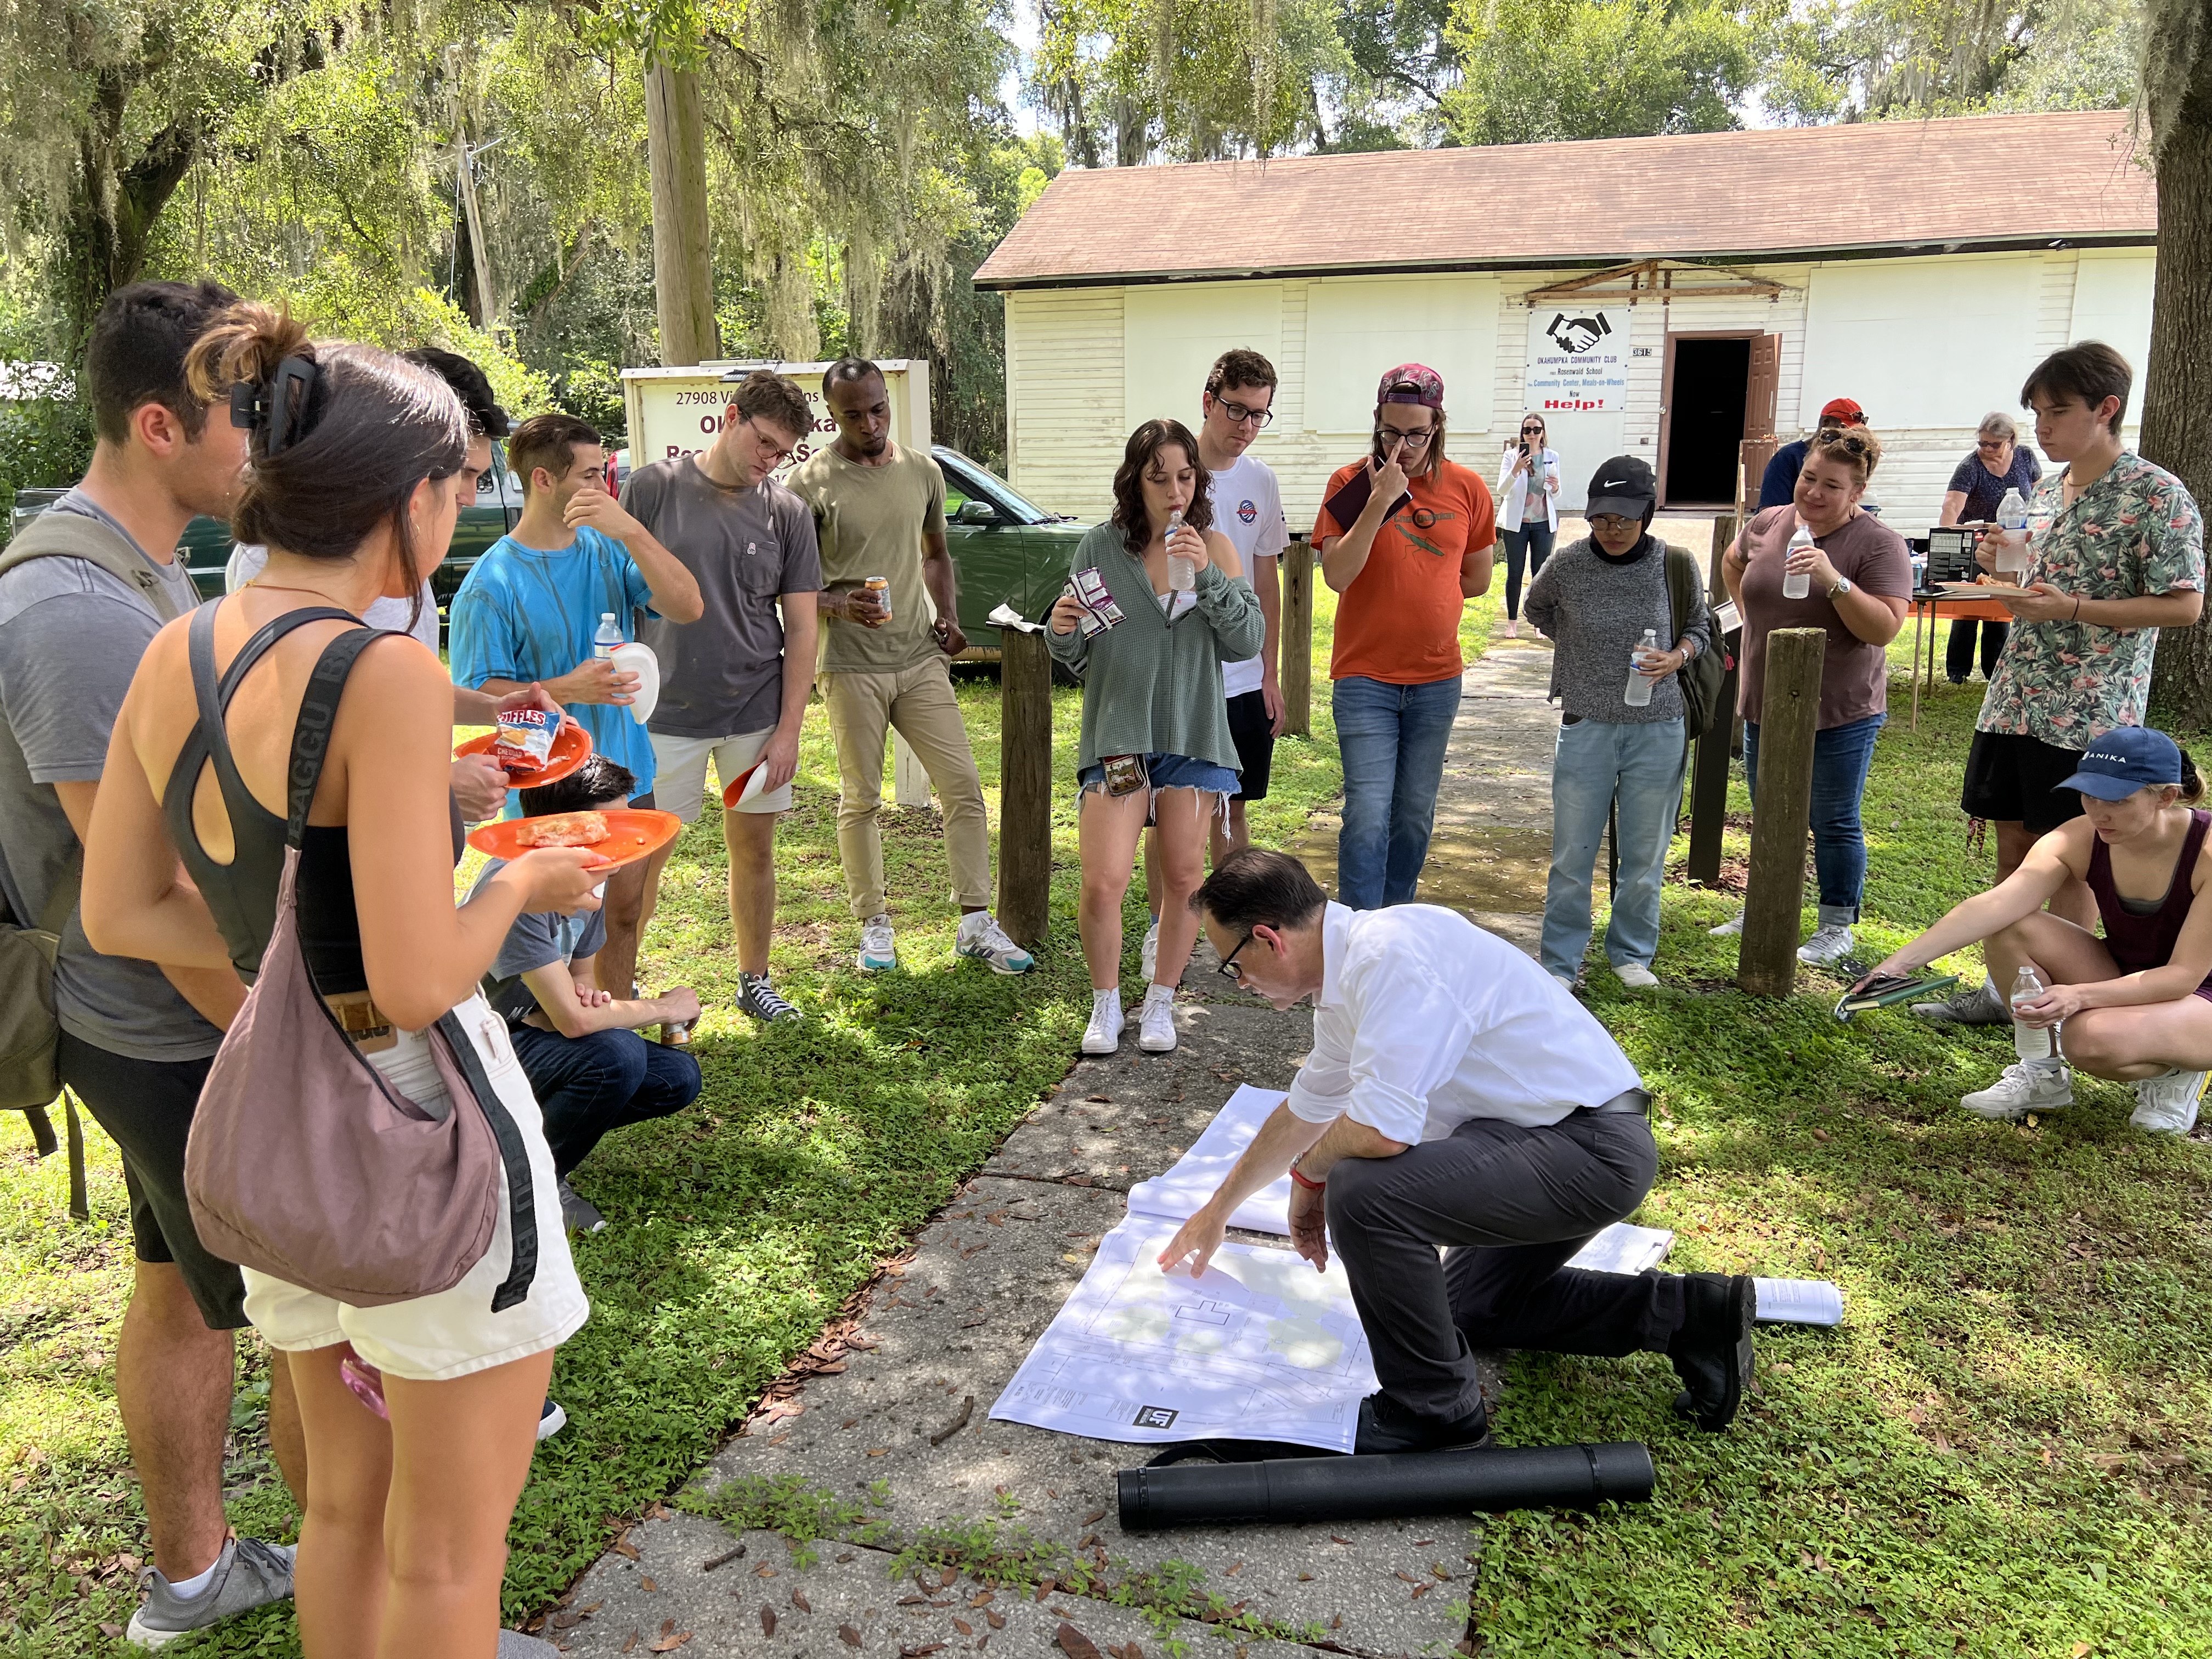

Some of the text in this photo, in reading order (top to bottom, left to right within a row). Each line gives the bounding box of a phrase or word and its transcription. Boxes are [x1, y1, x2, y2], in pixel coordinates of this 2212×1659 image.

[1633, 348, 1652, 356] 3615
[1534, 379, 1560, 387] Community
[1563, 379, 1581, 387] Center,
[676, 392, 717, 405] 27908
[1544, 399, 1604, 410] Help!
